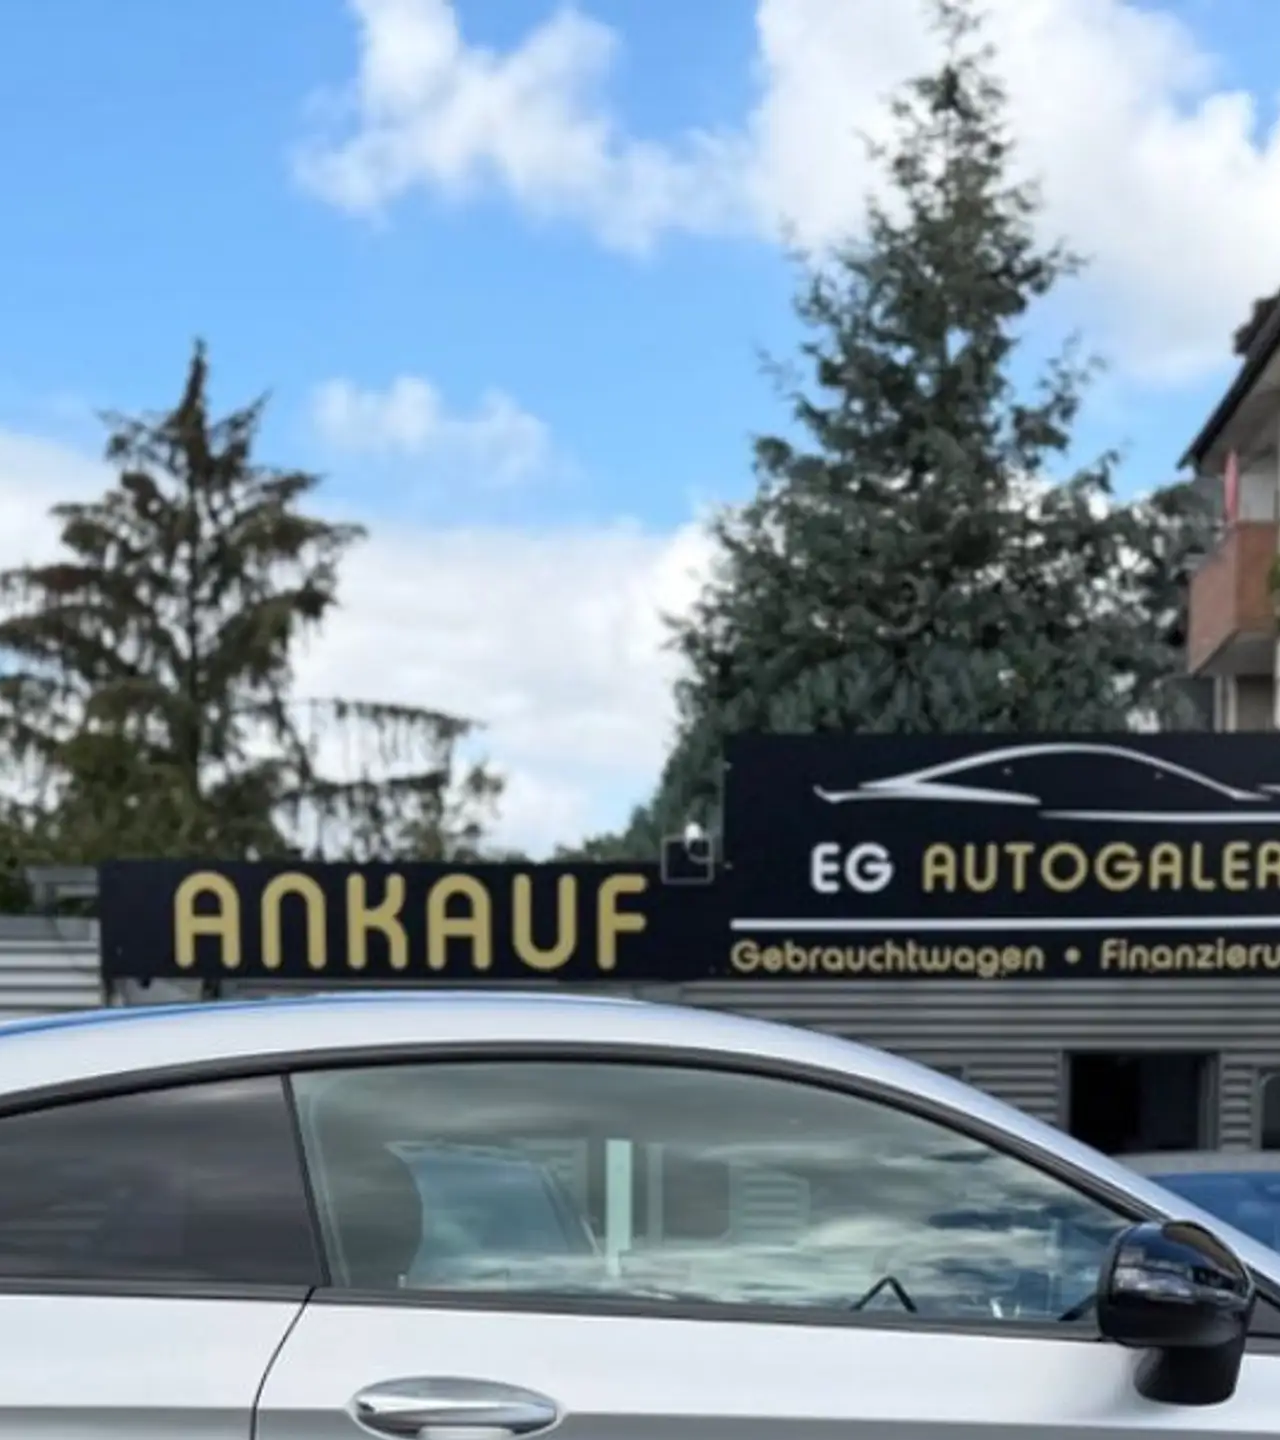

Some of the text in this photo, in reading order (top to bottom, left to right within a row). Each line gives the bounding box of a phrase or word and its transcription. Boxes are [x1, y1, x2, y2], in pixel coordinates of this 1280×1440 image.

[810, 842, 894, 893] EG
[174, 871, 648, 970] ANKAUF
[730, 939, 1046, 976] Gebrauchtwagen
